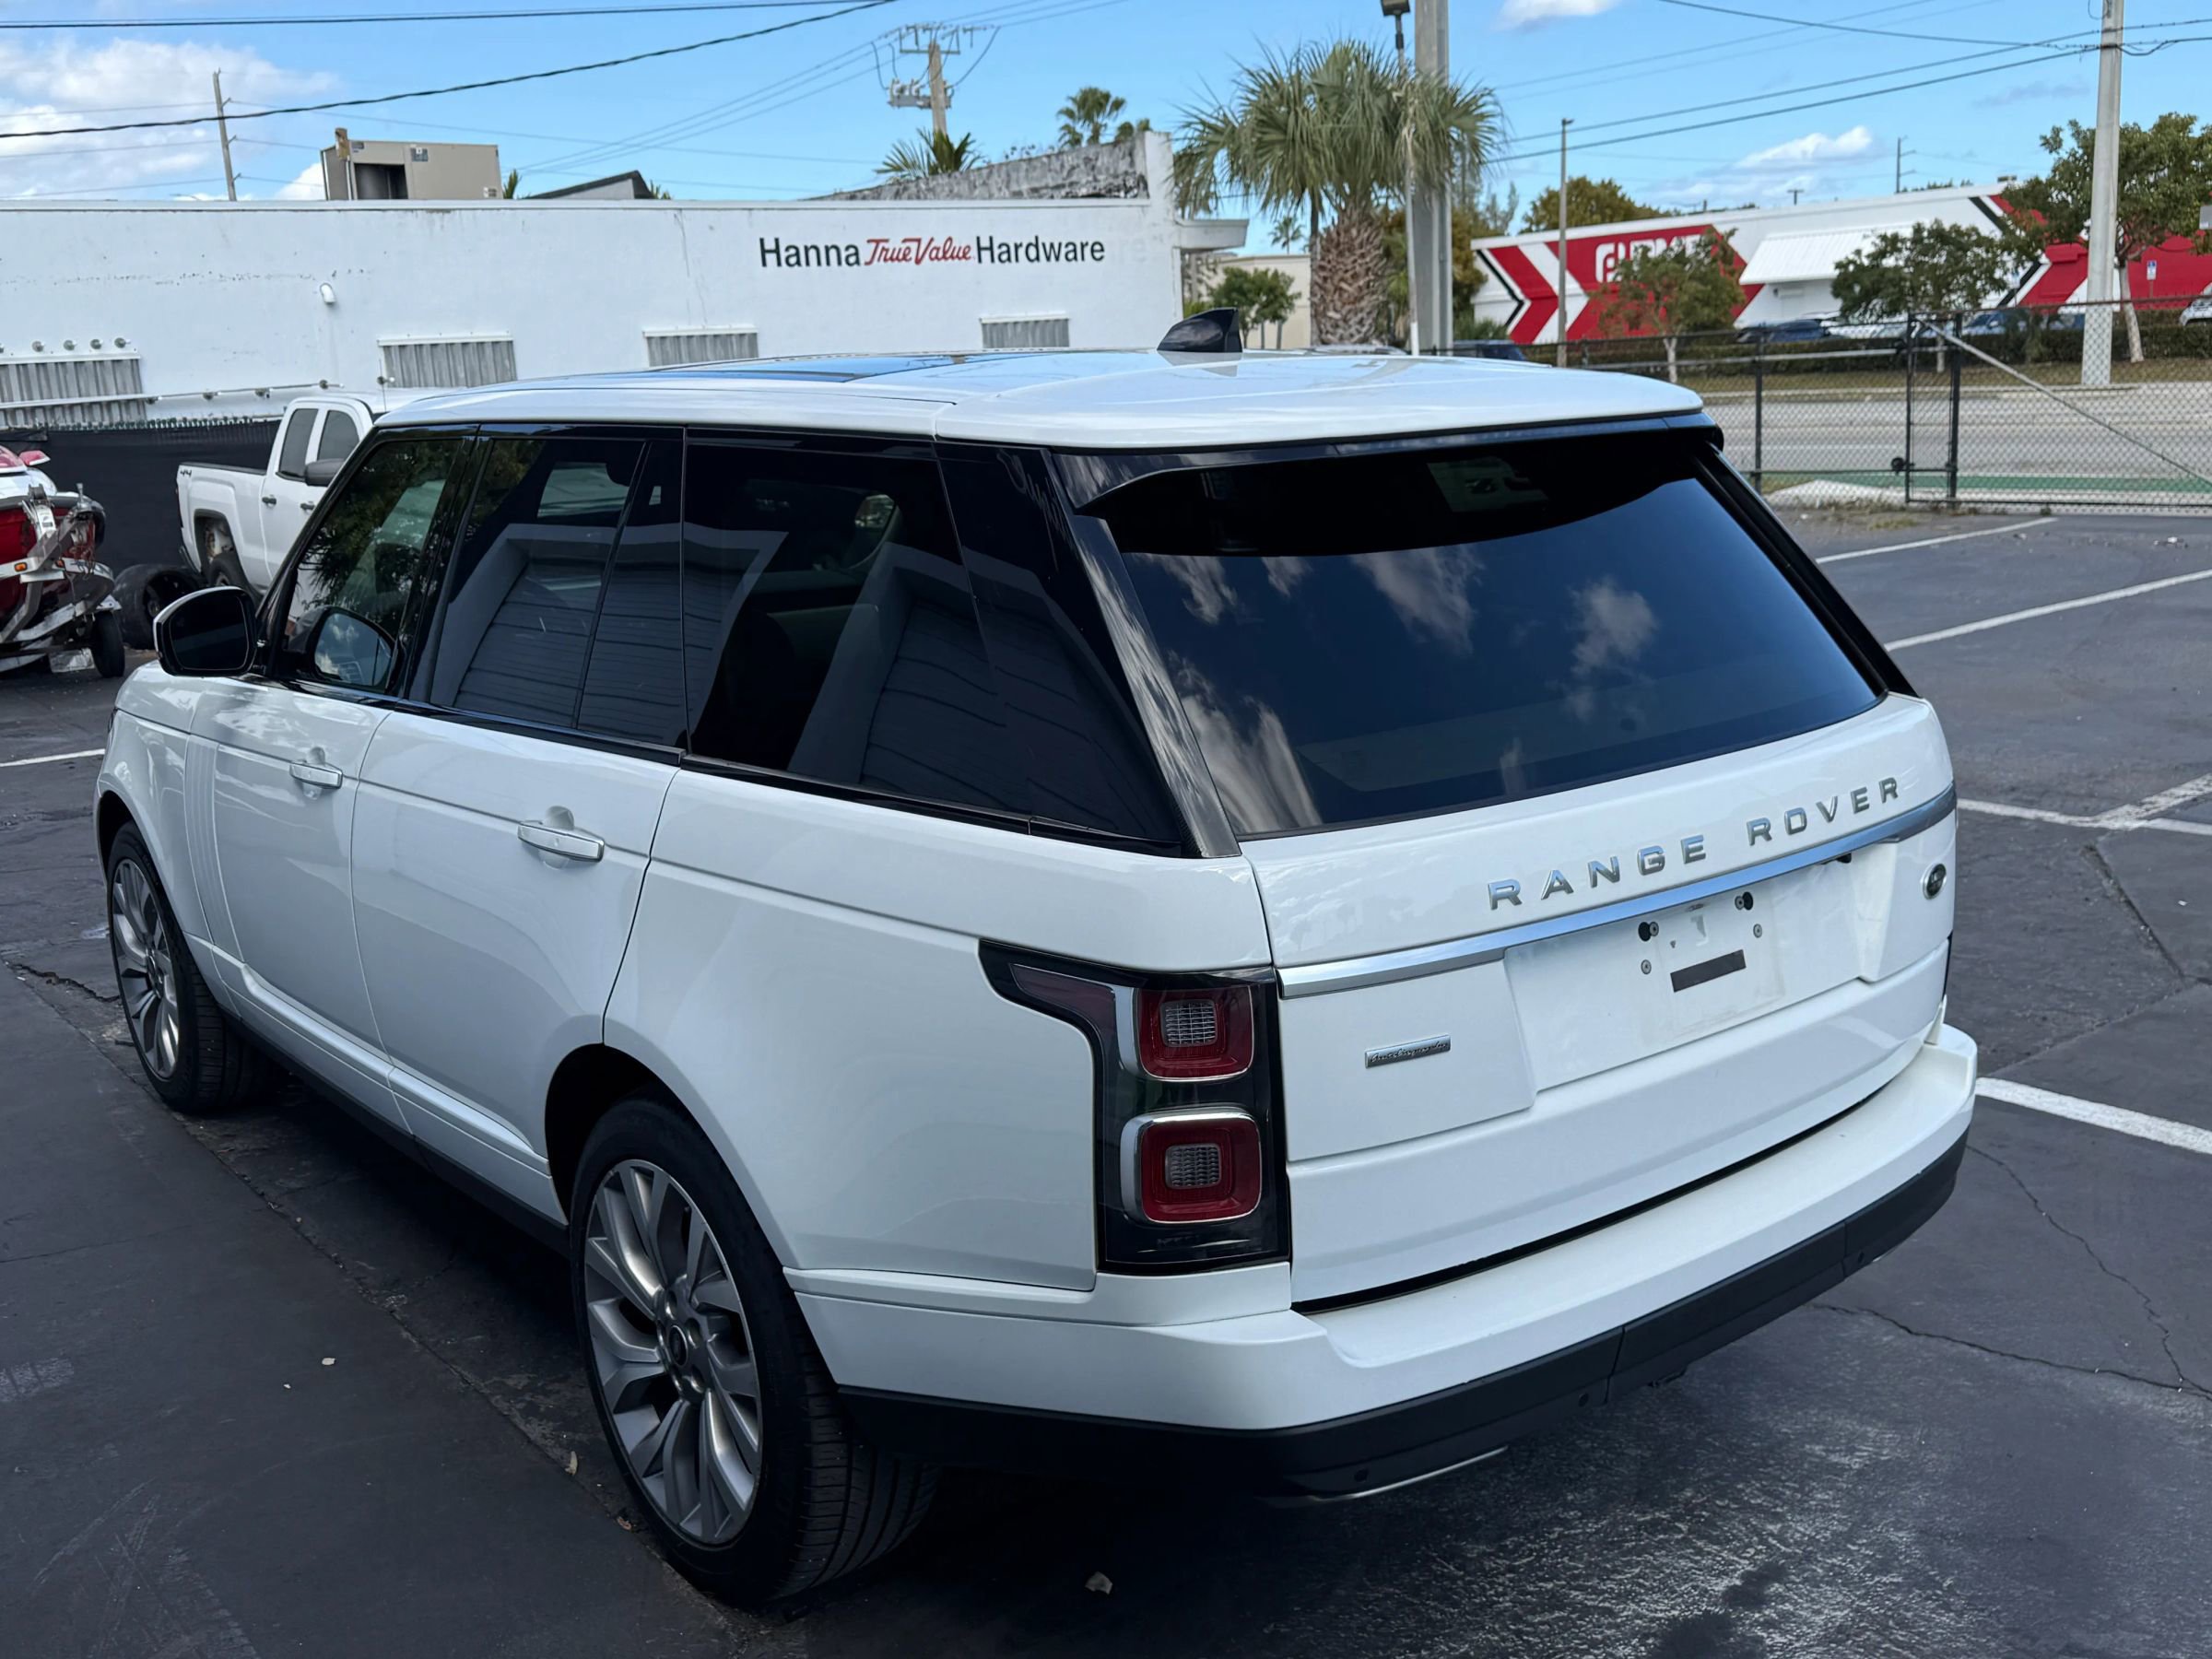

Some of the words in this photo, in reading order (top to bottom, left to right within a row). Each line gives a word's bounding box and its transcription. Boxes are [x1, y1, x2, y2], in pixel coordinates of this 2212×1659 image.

[759, 237, 862, 267] Hanna
[976, 235, 1106, 265] Hardware
[1488, 834, 1707, 911] RANGE
[1746, 777, 1899, 846] ROVER
